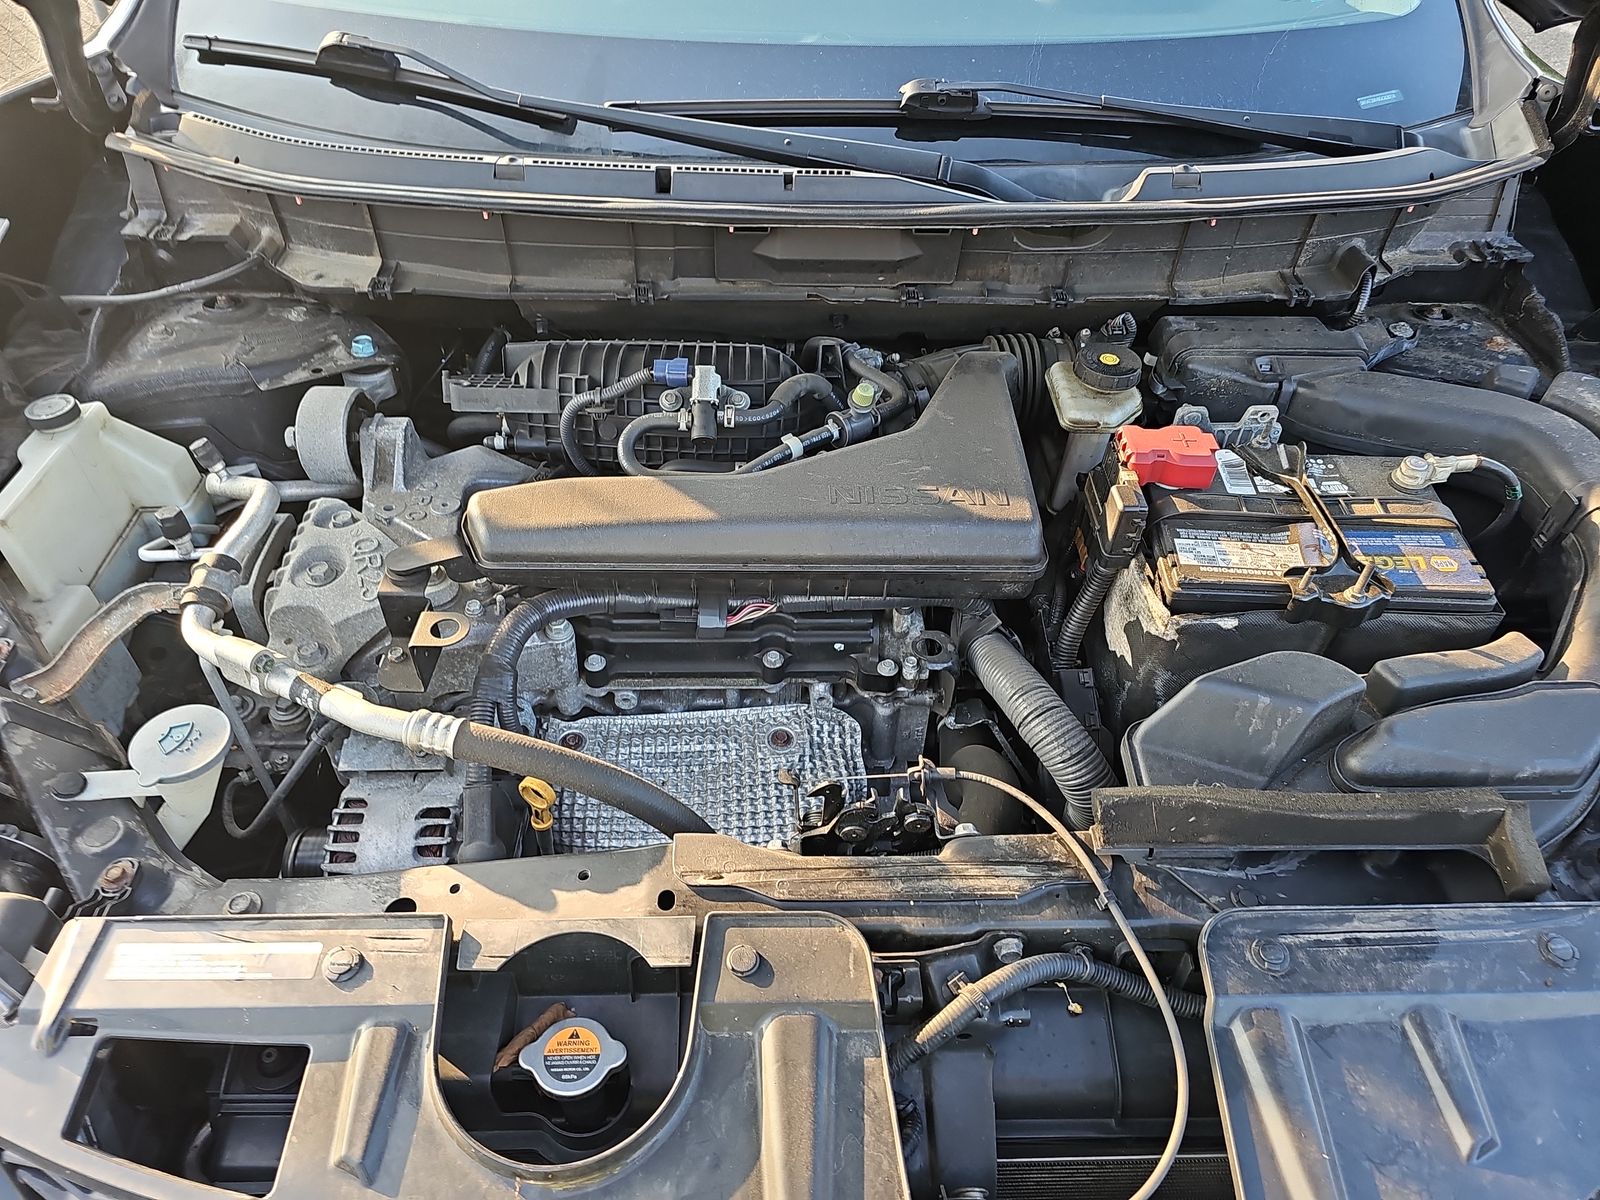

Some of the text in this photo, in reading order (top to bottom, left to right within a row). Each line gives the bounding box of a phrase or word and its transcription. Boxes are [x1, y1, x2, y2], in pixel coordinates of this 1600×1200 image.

[828, 485, 1011, 507] NISSAN
[1434, 559, 1456, 568] NAPA
[1199, 566, 1274, 576] DANGER/POISON
